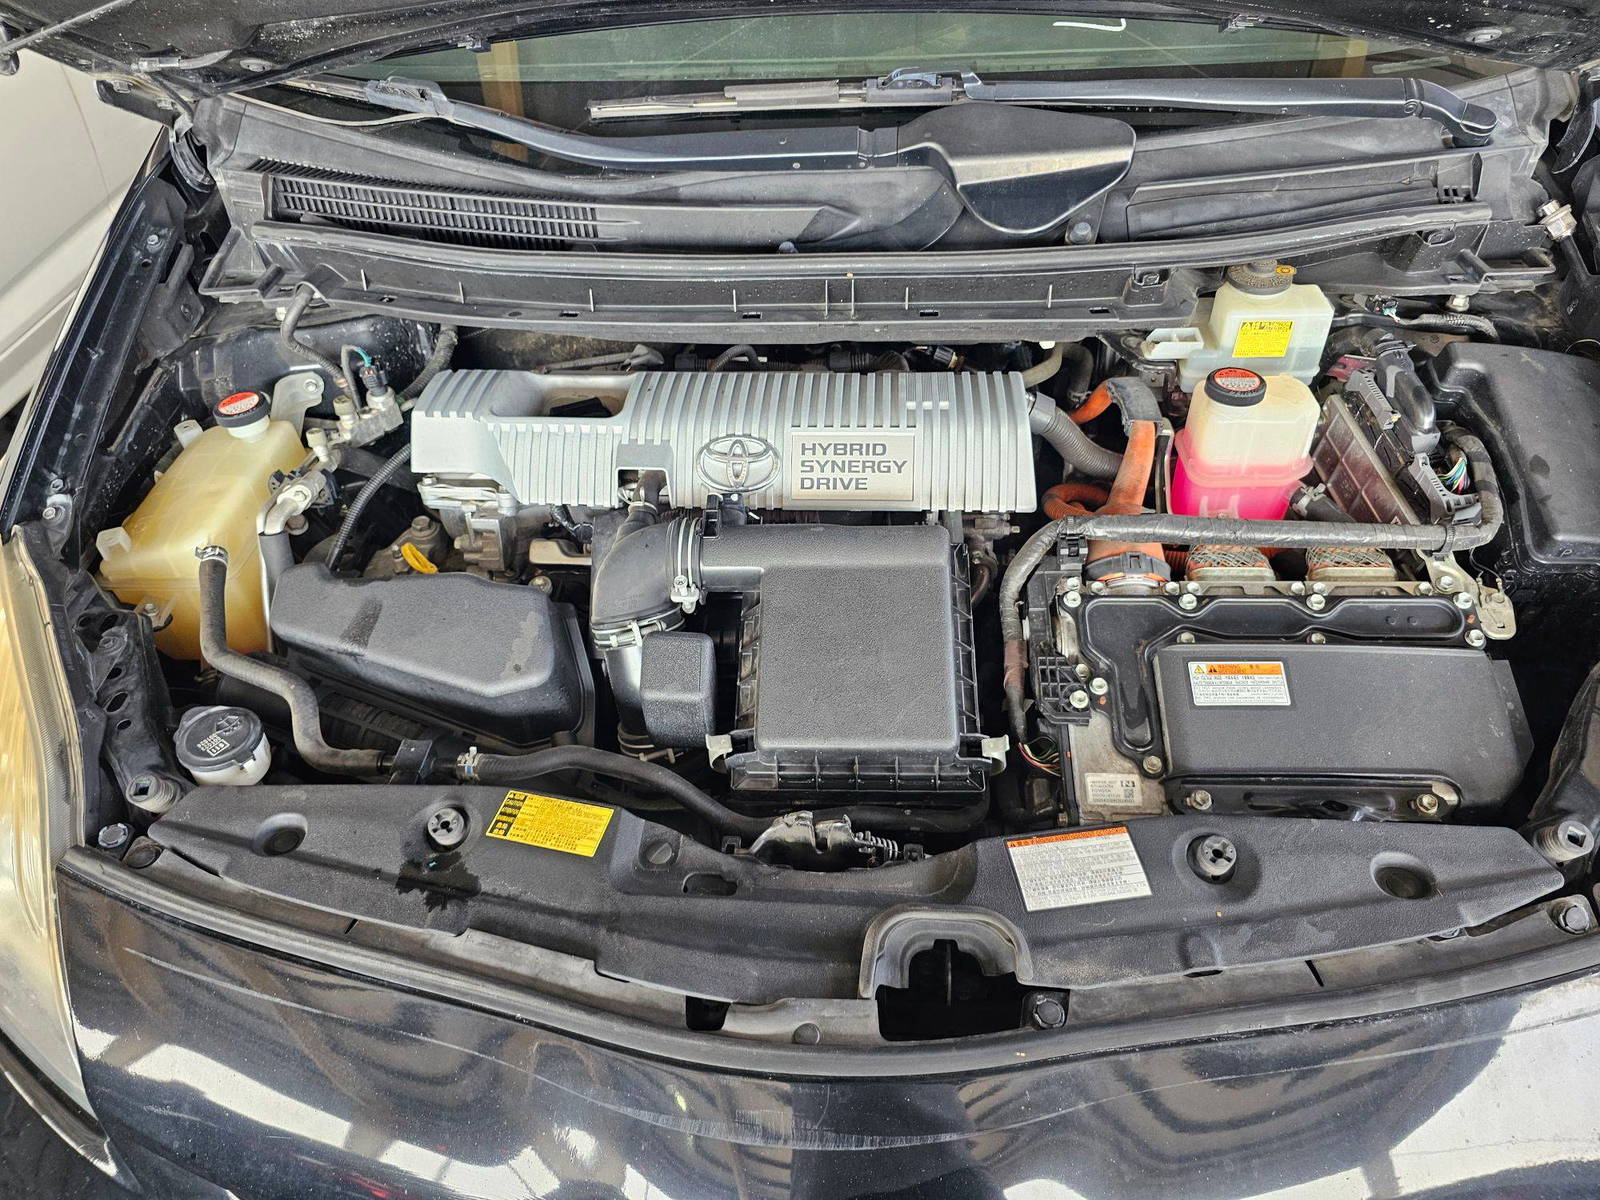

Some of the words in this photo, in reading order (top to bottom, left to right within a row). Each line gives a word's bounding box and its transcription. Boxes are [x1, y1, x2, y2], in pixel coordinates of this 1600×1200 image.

[801, 443, 887, 456] HYBRID
[800, 460, 908, 474] SYNERGY
[800, 477, 868, 490] DRIVE
